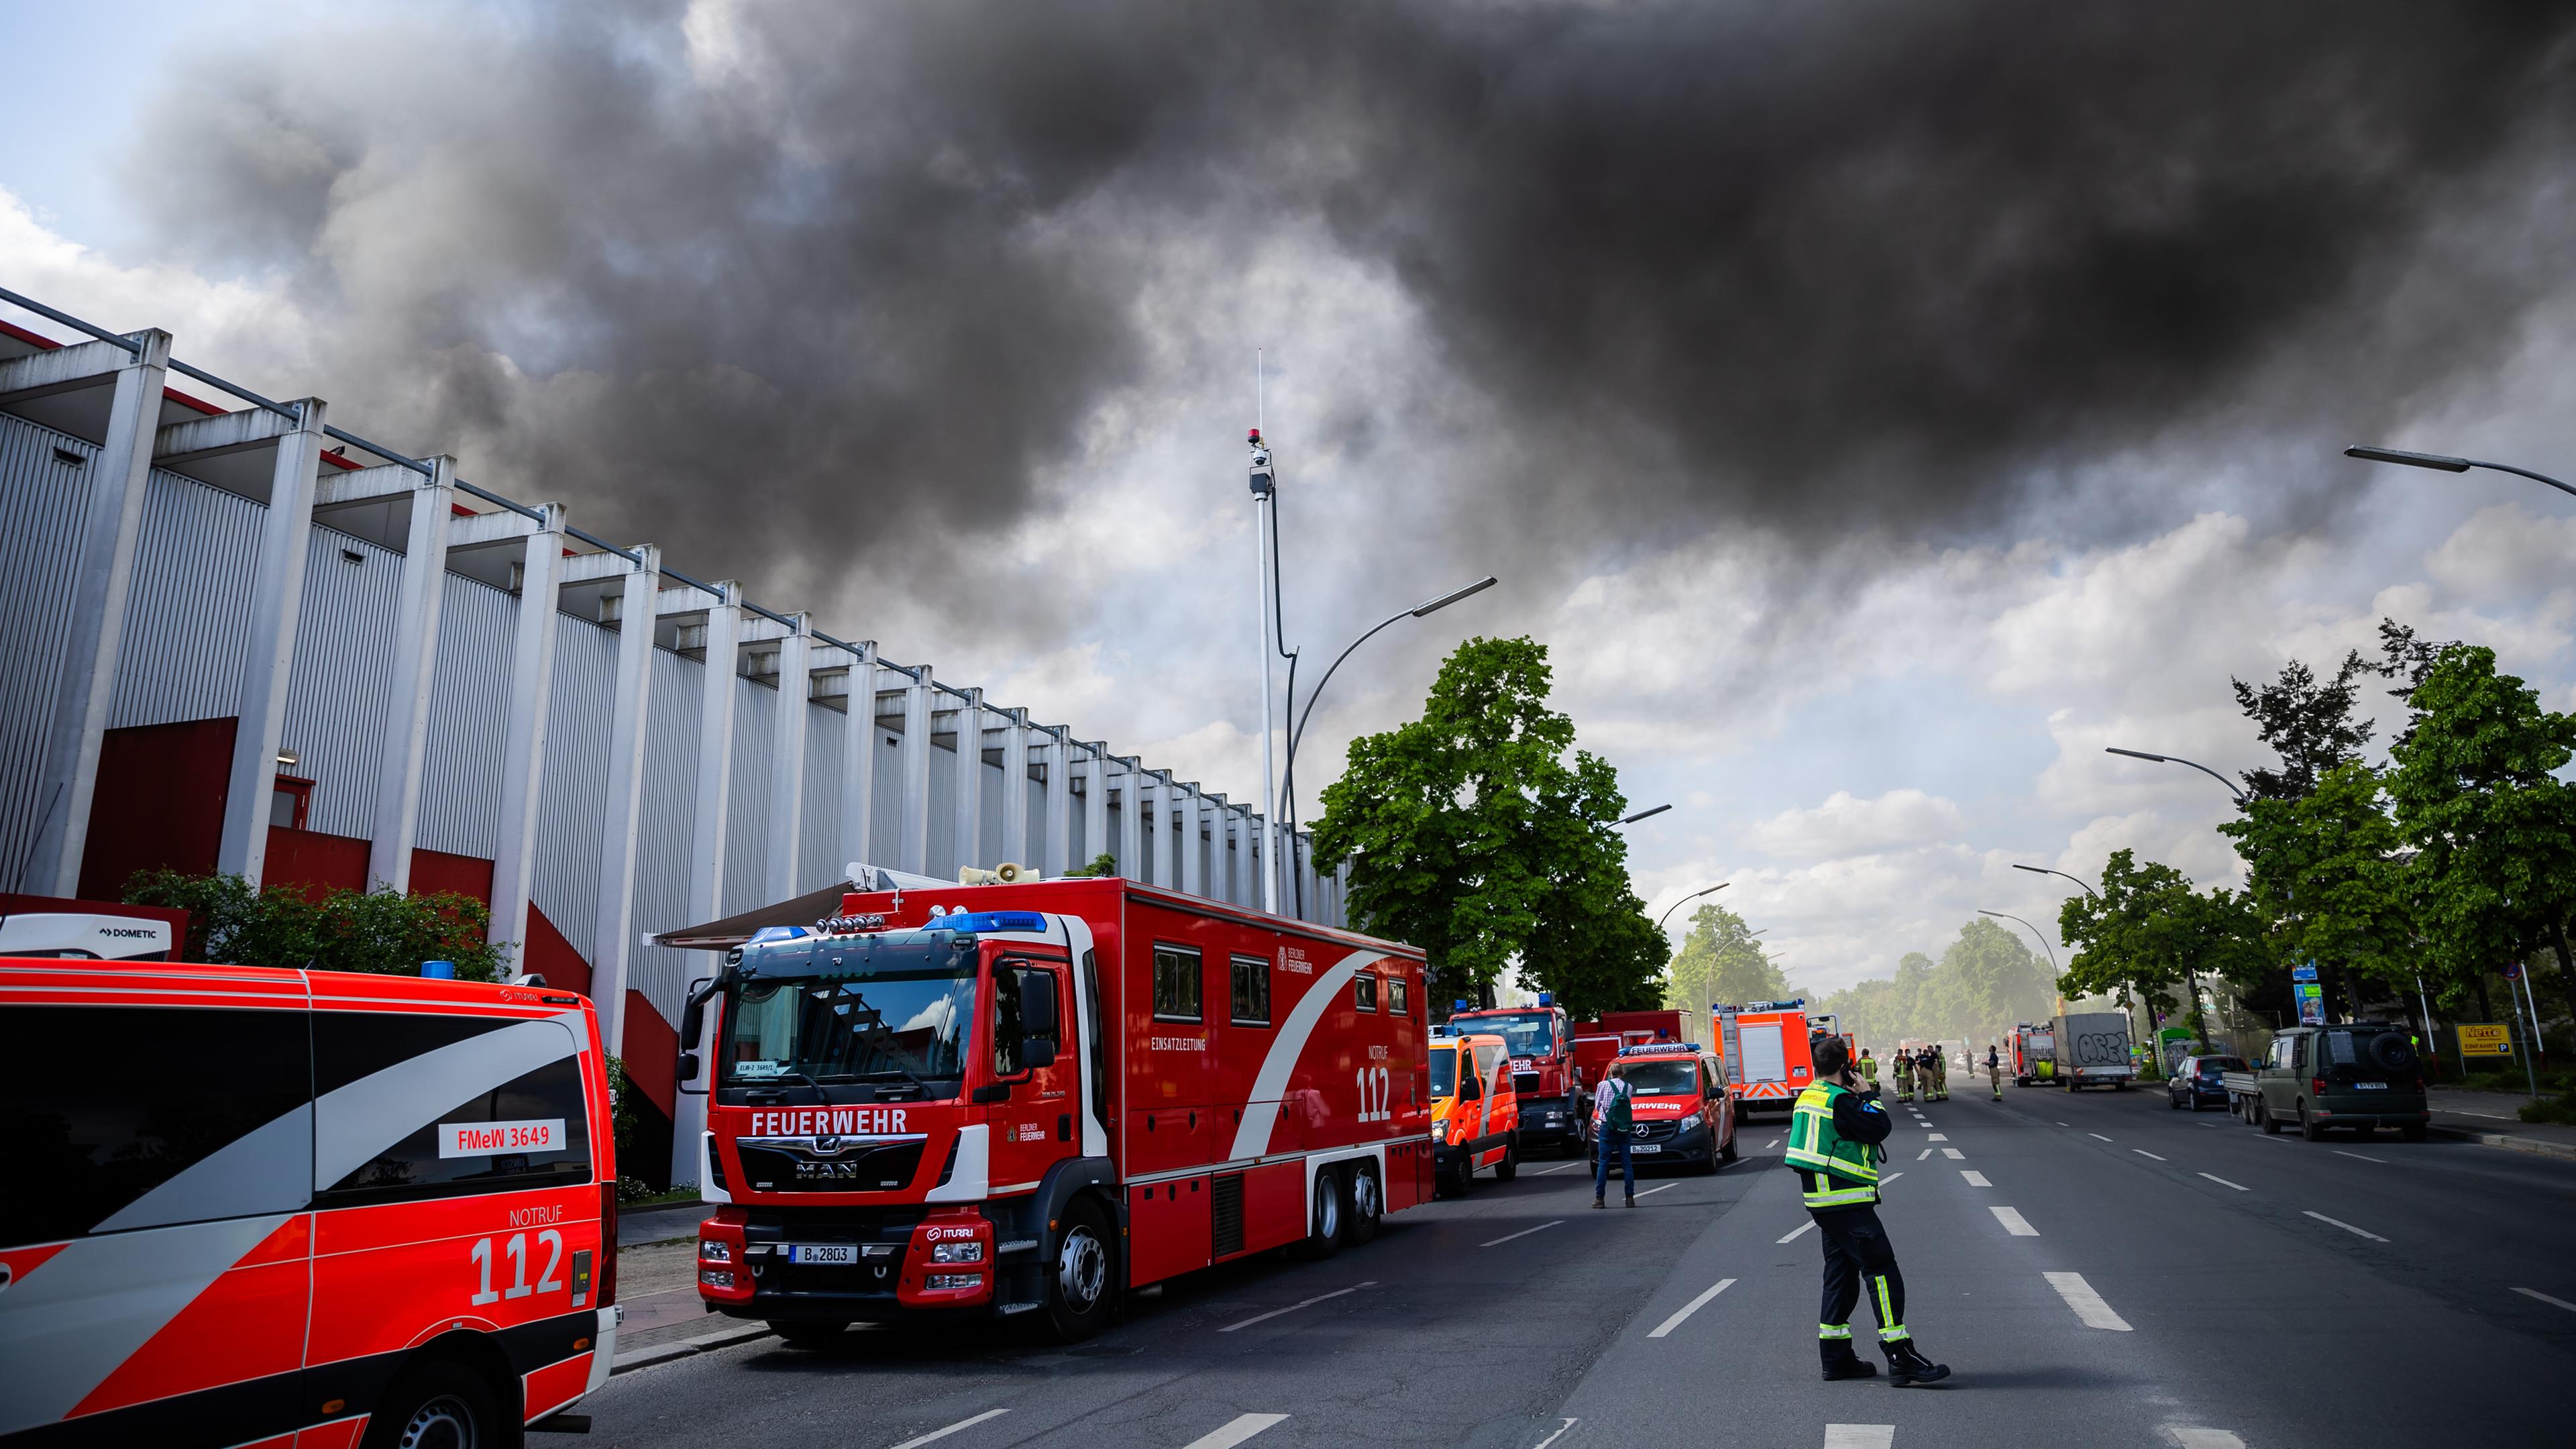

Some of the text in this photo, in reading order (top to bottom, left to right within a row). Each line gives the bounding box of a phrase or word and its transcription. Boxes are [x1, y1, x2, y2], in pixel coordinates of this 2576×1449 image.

[113, 928, 156, 938] DOMETIC
[1288, 947, 1305, 960] BERLINER
[1288, 959, 1312, 974] FEUERWEHR
[2466, 1027, 2501, 1037] Netto
[1151, 1037, 1205, 1051] EINSATZLEITUNG
[1632, 1045, 1685, 1054] FEUERWEHR
[1368, 1045, 1388, 1060] NOTRUF
[1356, 1067, 1391, 1123] 112
[752, 1110, 906, 1135] FEUERWEHR
[1020, 1123, 1038, 1132] BERLINER
[458, 1126, 549, 1150] FMeW 3649
[1020, 1131, 1045, 1141] FEUERWEHR
[796, 1164, 857, 1179] MAN
[510, 1205, 562, 1227] NOTRUF
[943, 1228, 973, 1238] ITURRI
[805, 1248, 848, 1261] B 2803
[471, 1229, 562, 1306] 112
